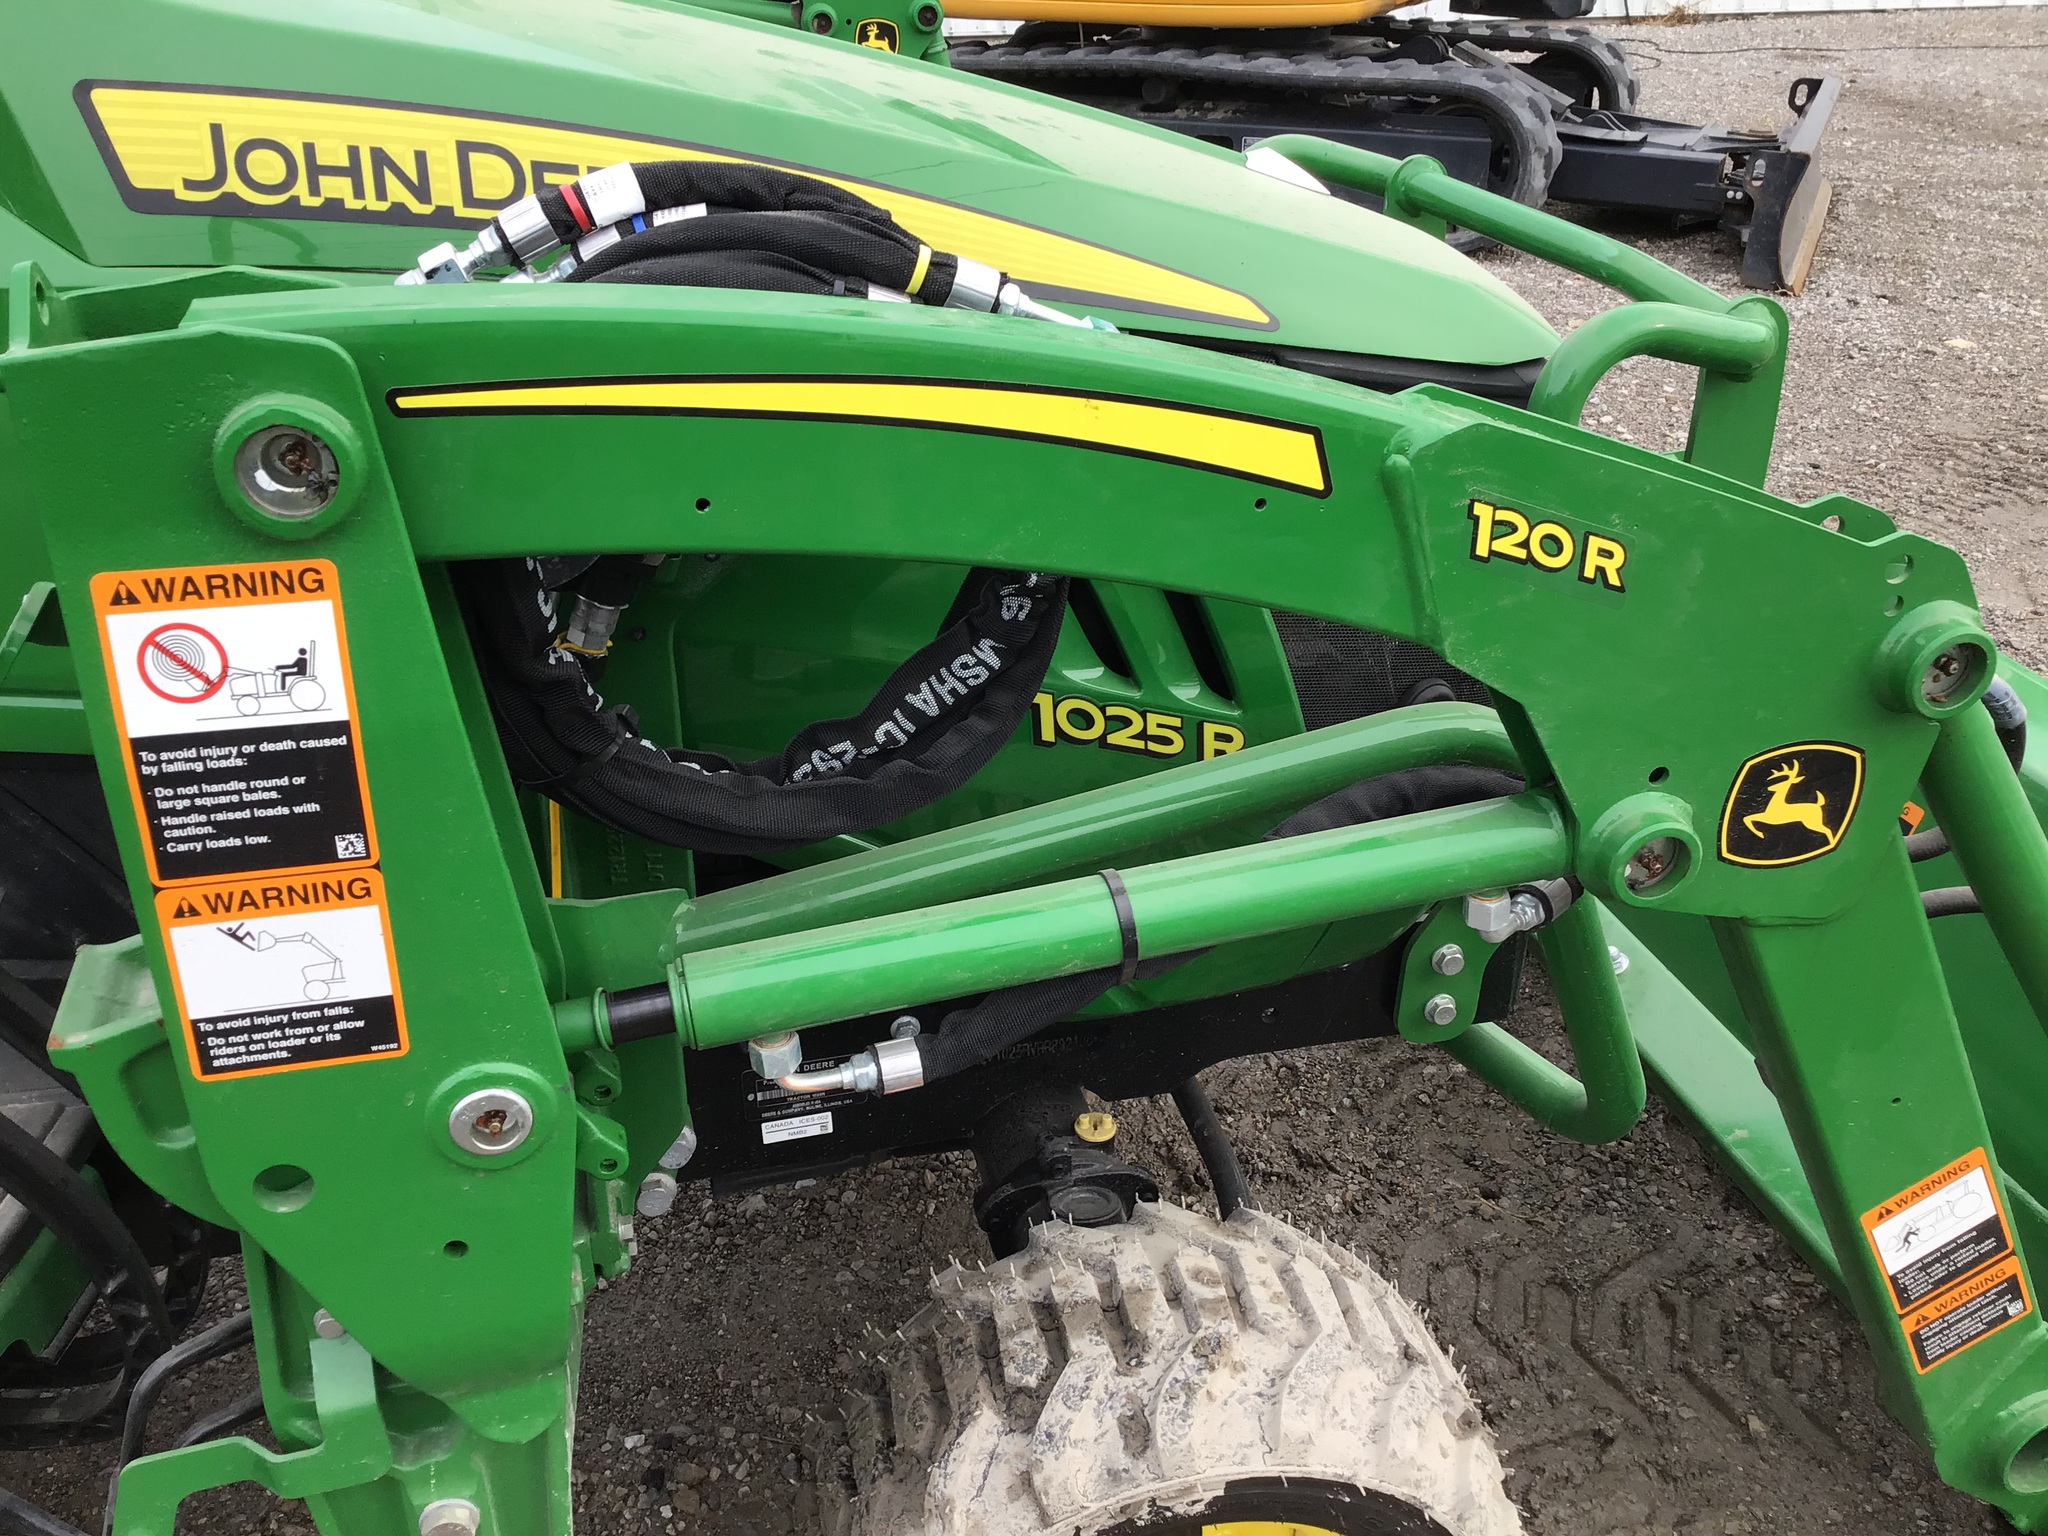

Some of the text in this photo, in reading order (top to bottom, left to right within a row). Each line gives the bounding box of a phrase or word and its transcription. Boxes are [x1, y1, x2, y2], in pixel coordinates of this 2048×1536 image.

[180, 122, 433, 206] JOHN
[1469, 500, 1626, 590] 120 R
[141, 567, 325, 603] WARNING
[1033, 692, 1185, 757] 1025
[139, 735, 348, 762] To avoid injury or death caused
[141, 756, 248, 776] by falling loads:
[154, 776, 306, 797] Do not handle round or
[156, 789, 281, 810] large square bales.
[160, 802, 320, 826] Handle raised loads with
[163, 825, 216, 838] caution.
[166, 834, 271, 853] Carry loads low.
[203, 877, 372, 915] WARNING
[197, 1005, 354, 1032] To avoid injury from falls:
[207, 1018, 365, 1047] Do not work from or allow
[209, 1032, 342, 1057] riders on loader or its
[212, 1051, 292, 1067] attachments.
[803, 1060, 835, 1072] DEERE
[765, 1121, 793, 1130] CANADA
[1894, 1161, 1970, 1209] WARNING
[1904, 1277, 1915, 1286] Do
[1914, 1271, 1926, 1280] not
[1925, 1262, 1942, 1274] walk
[1949, 1242, 1976, 1261] perform
[1905, 1261, 1923, 1274] avoid
[1922, 1252, 1941, 1264] injury
[1941, 1242, 1957, 1253] from
[1956, 1230, 1978, 1245] falling
[1906, 1274, 1931, 1290] service
[1929, 1263, 1949, 1277] under
[1953, 1248, 1975, 1263] raised
[1908, 1281, 1928, 1295] Lower
[1928, 1269, 1949, 1284] loader
[1956, 1251, 1981, 1269] ground
[1979, 1241, 1997, 1254] when
[1909, 1283, 1935, 1300] parked.
[1934, 1269, 2007, 1312] WARNING
[1929, 1318, 1943, 1329] NOT
[1985, 1281, 2009, 1297] without
